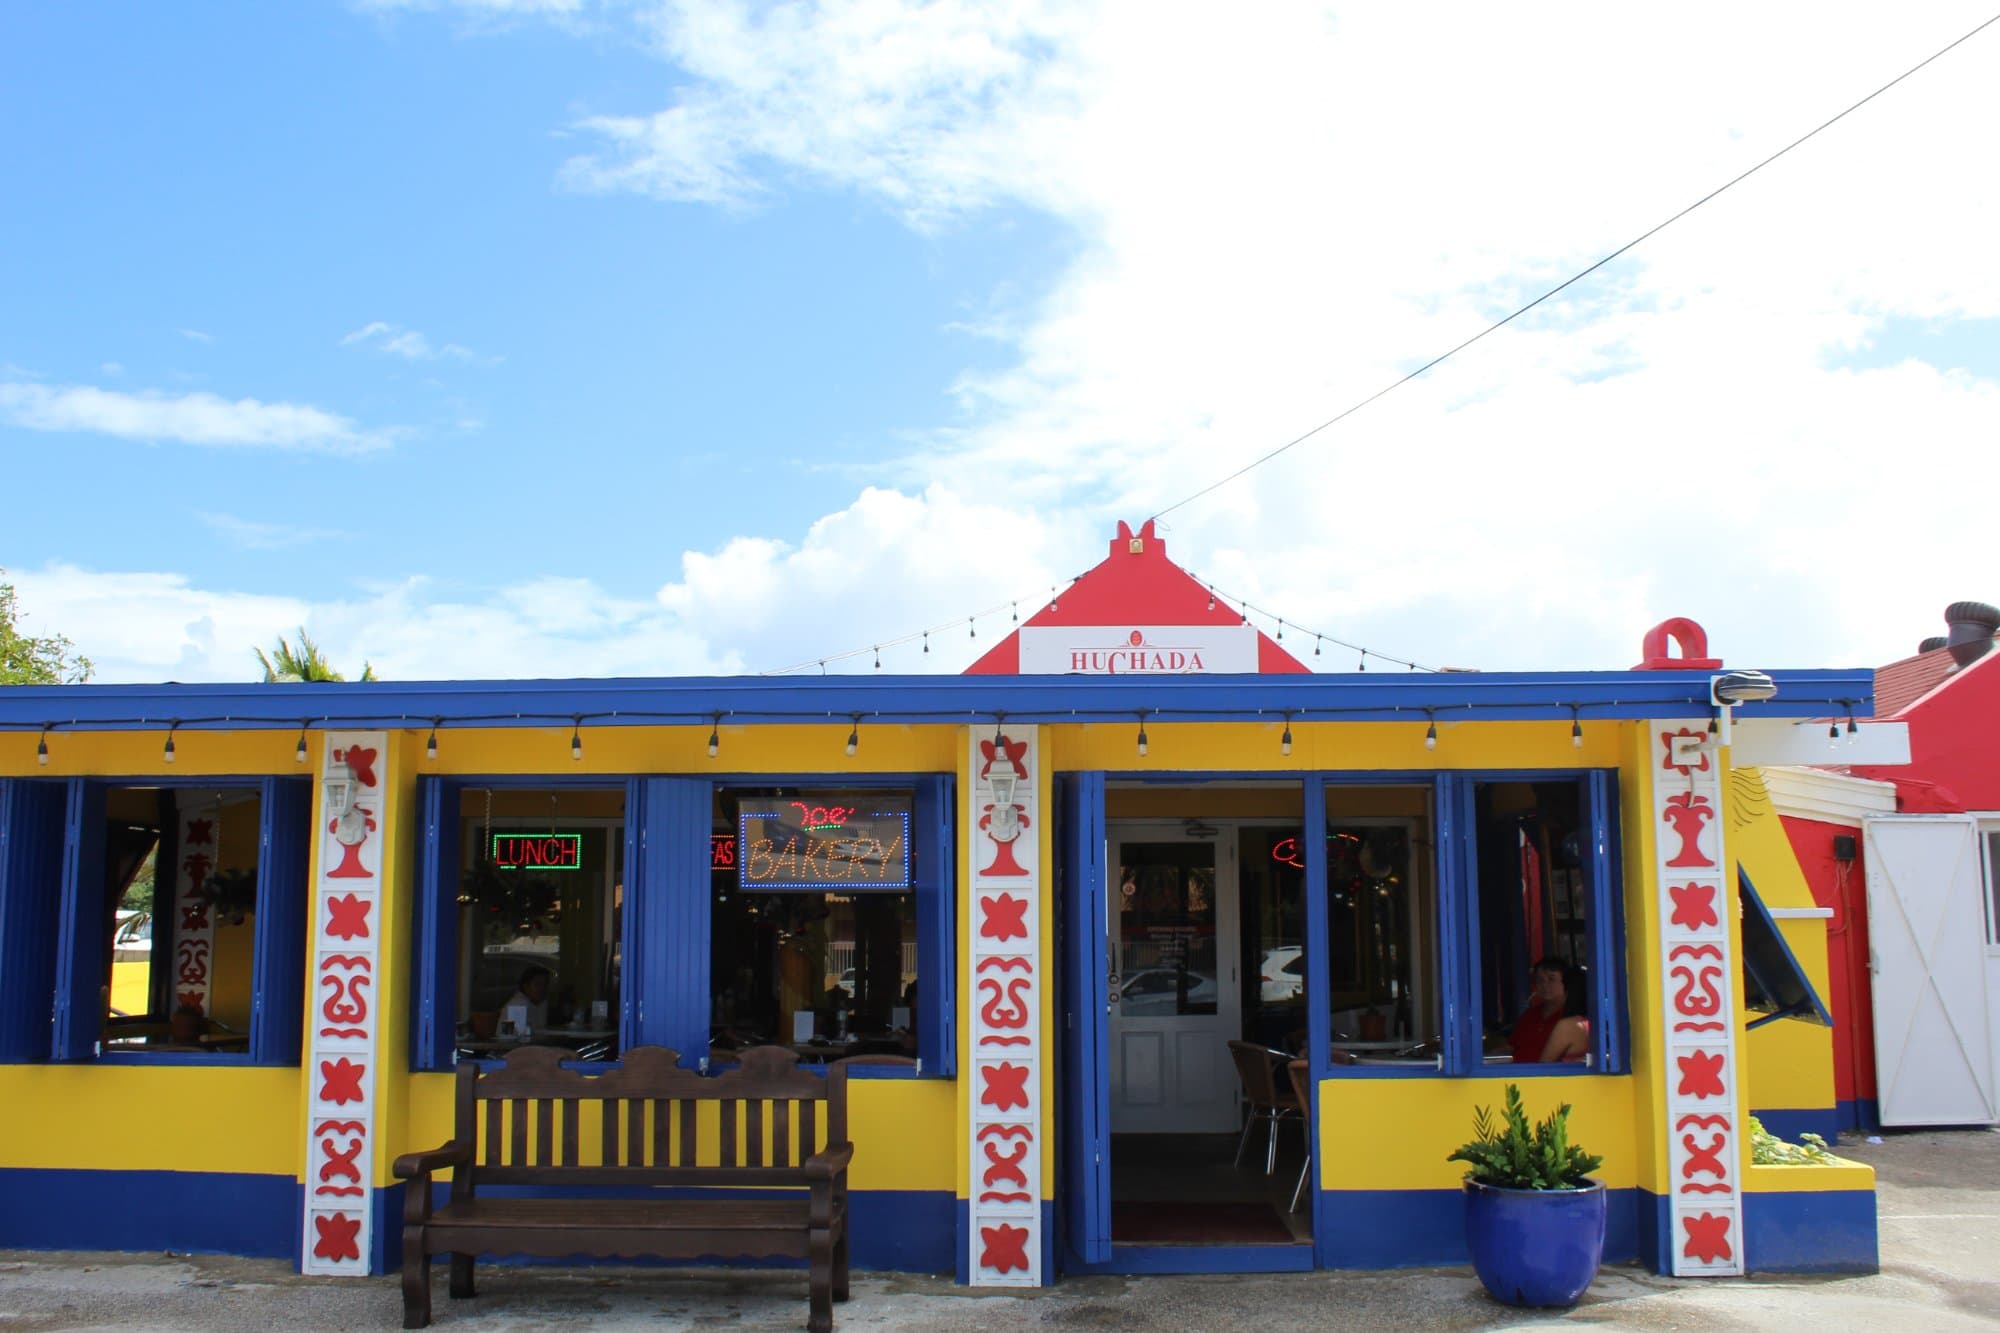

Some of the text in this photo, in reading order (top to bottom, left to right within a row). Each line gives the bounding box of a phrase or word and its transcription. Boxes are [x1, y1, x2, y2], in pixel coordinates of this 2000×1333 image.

[1071, 651, 1204, 674] HUCHADA
[496, 838, 577, 865] LUNCH
[749, 835, 901, 880] BAKERY
